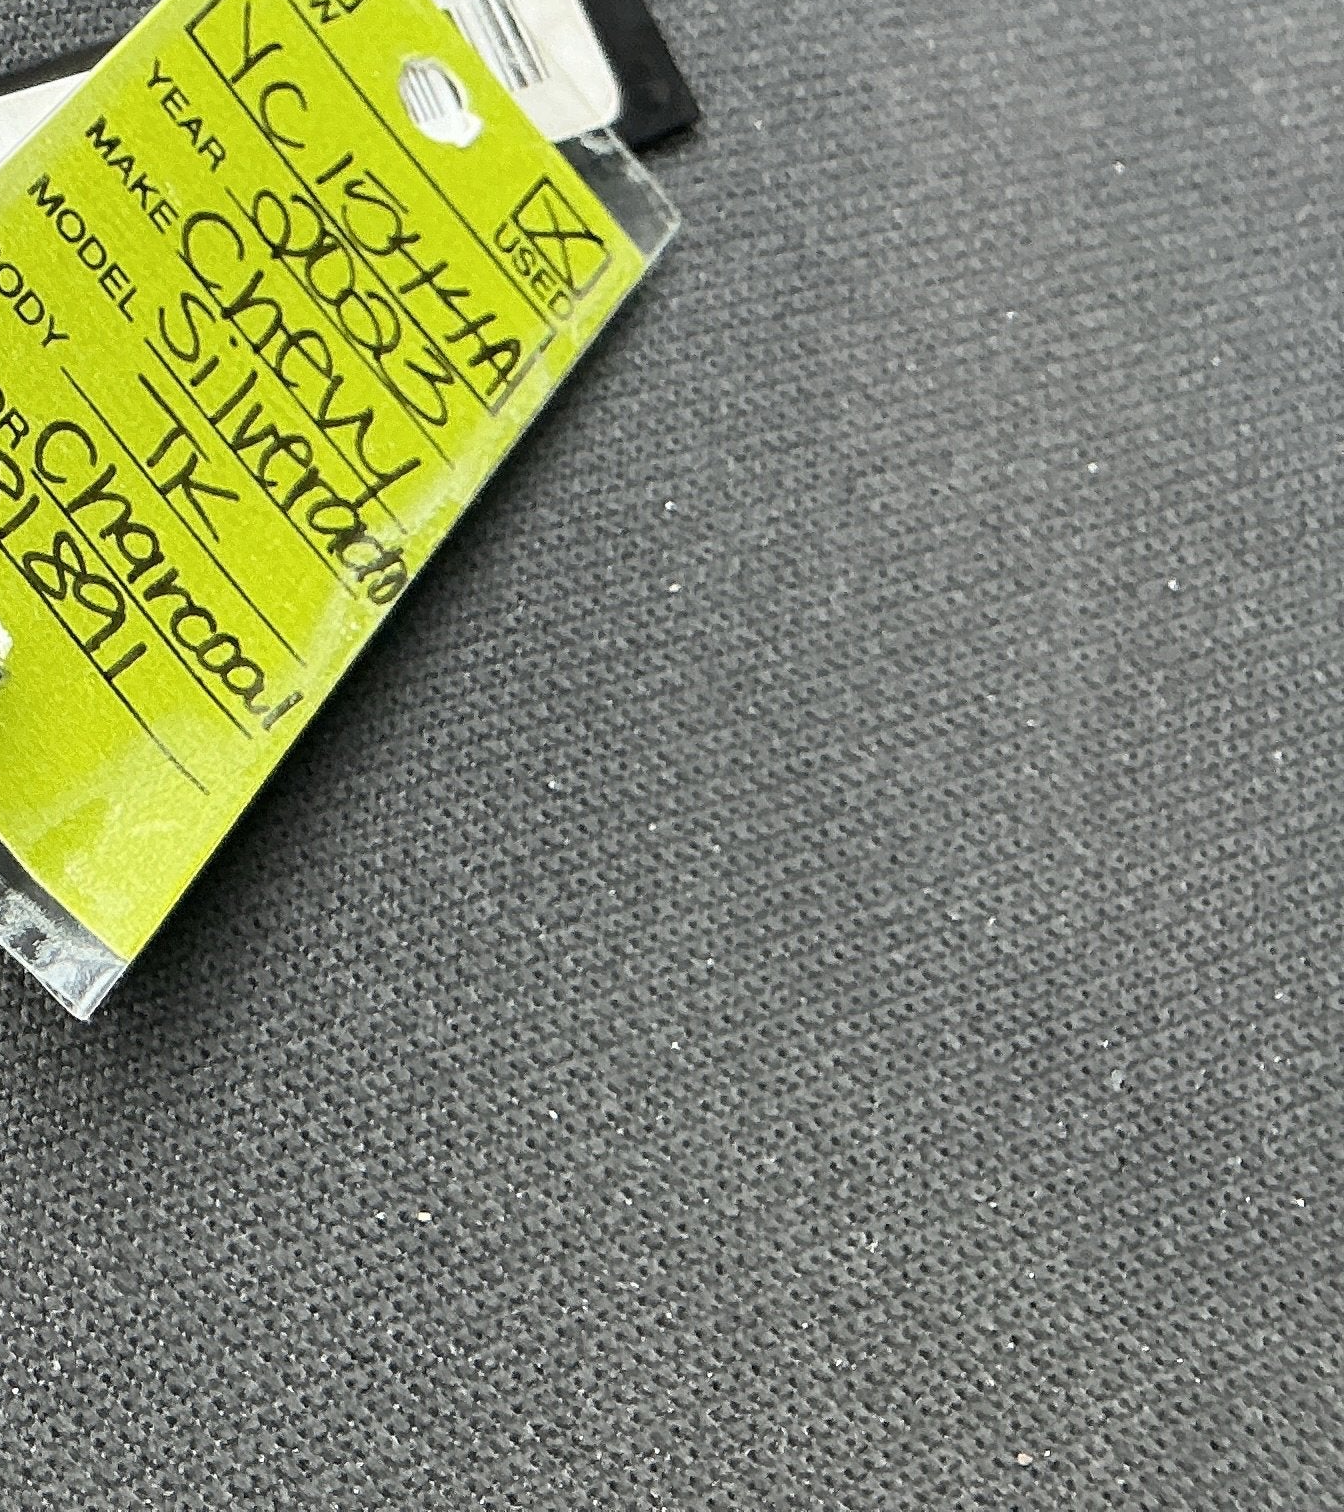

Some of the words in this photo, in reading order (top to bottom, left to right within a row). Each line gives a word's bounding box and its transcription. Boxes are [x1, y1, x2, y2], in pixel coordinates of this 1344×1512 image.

[84, 114, 180, 234] MAKE
[145, 57, 230, 172] YEAR
[26, 174, 140, 323] MODEL
[252, 189, 449, 427] 2023
[492, 221, 575, 320] USED
[181, 211, 421, 508] Chevy
[137, 373, 240, 544] TK
[158, 292, 409, 605] Silverado
[34, 420, 304, 732] Charcoal
